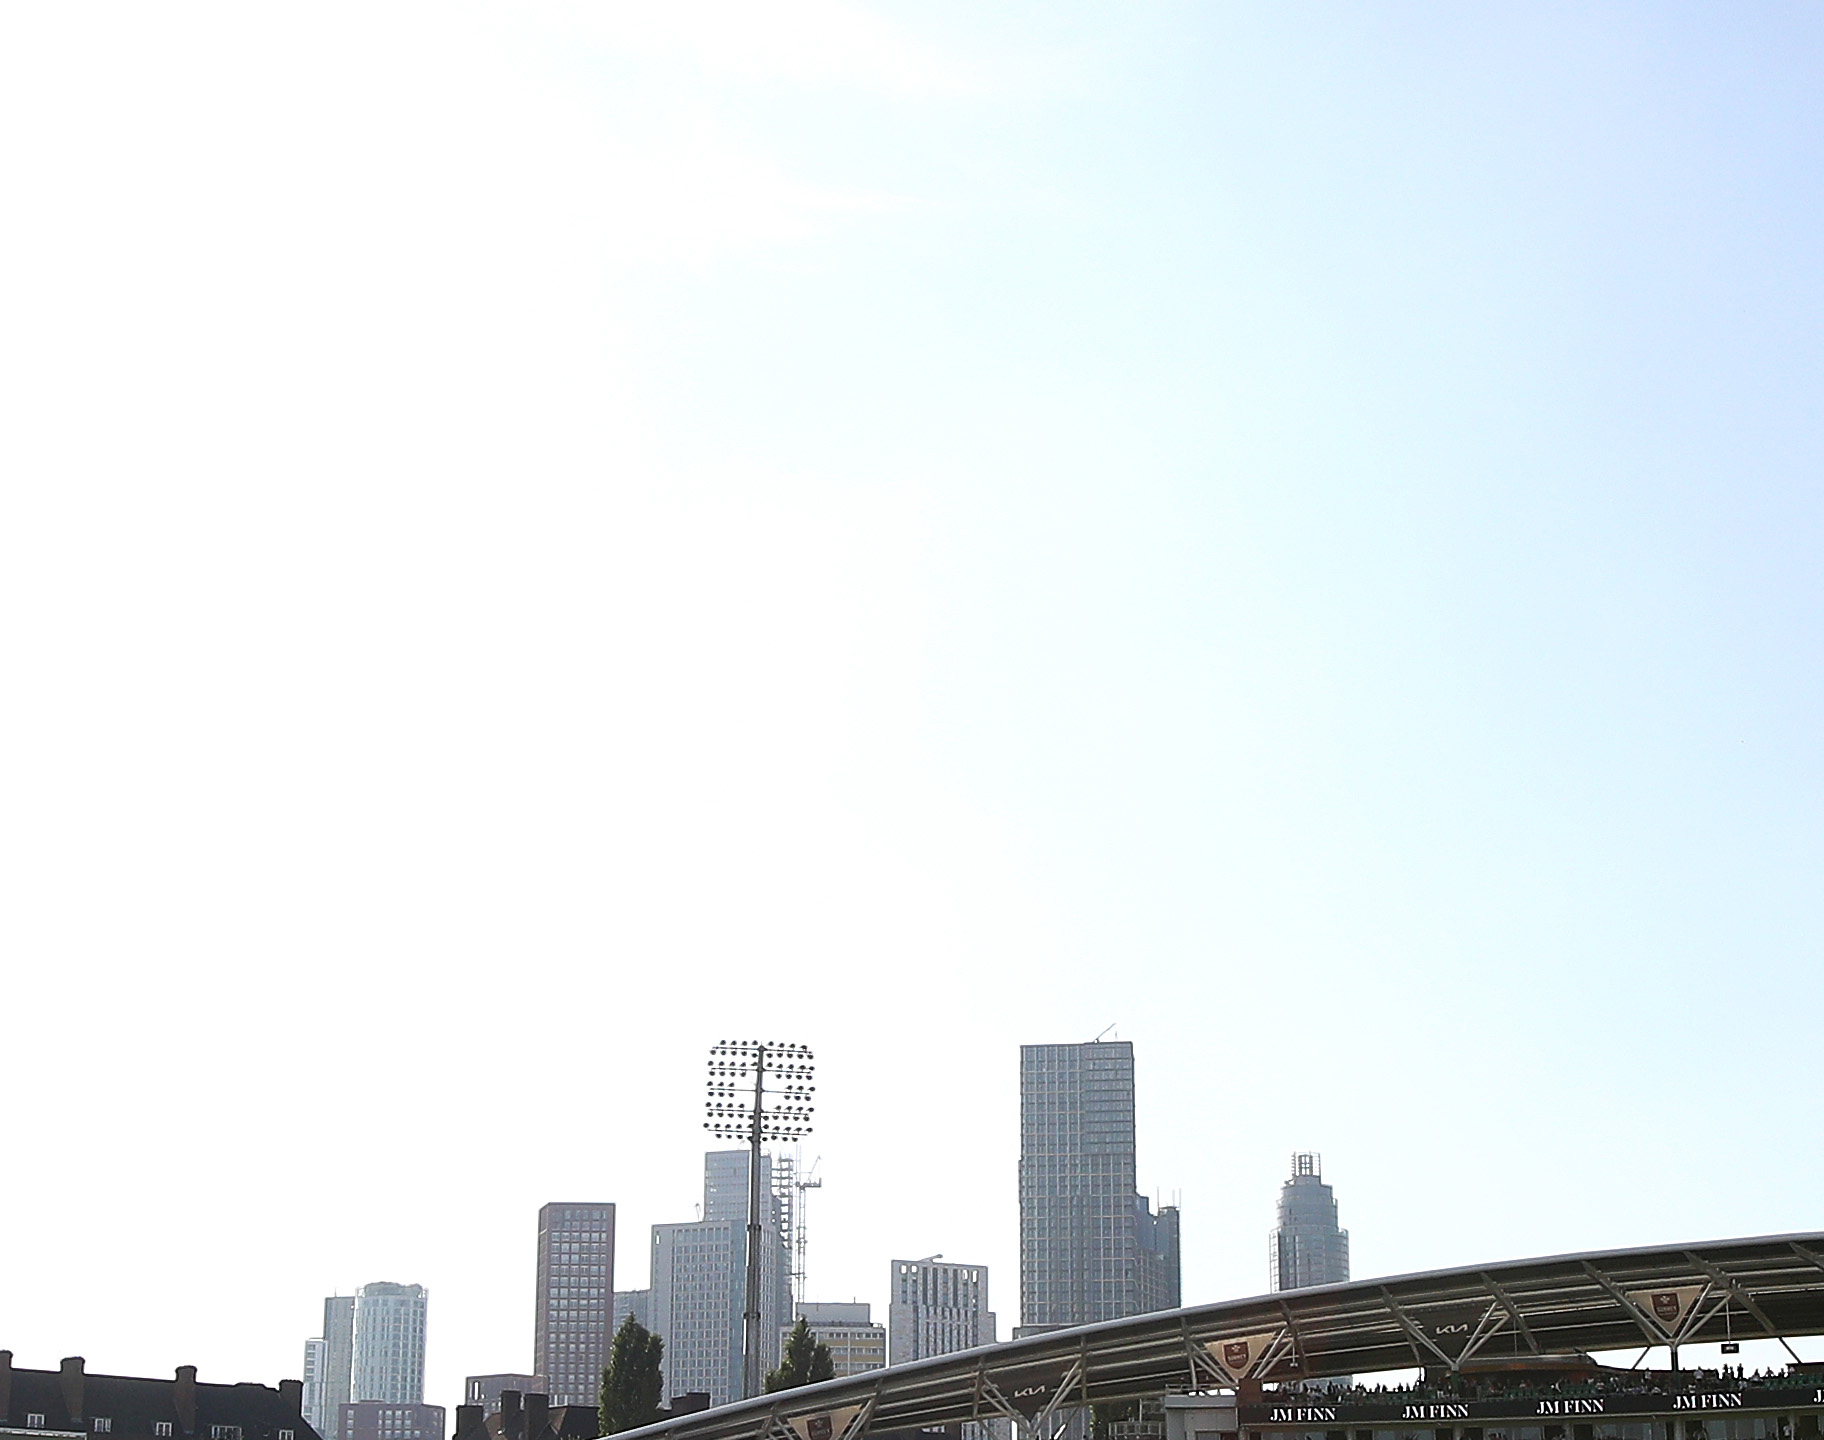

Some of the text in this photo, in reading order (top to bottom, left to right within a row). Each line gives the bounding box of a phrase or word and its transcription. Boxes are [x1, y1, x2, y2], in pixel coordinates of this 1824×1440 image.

[1536, 1399, 1604, 1414] JM FINN
[1673, 1393, 1743, 1410] JM FINN
[1270, 1407, 1336, 1422] JM FINN
[1402, 1404, 1468, 1419] JM FINN
